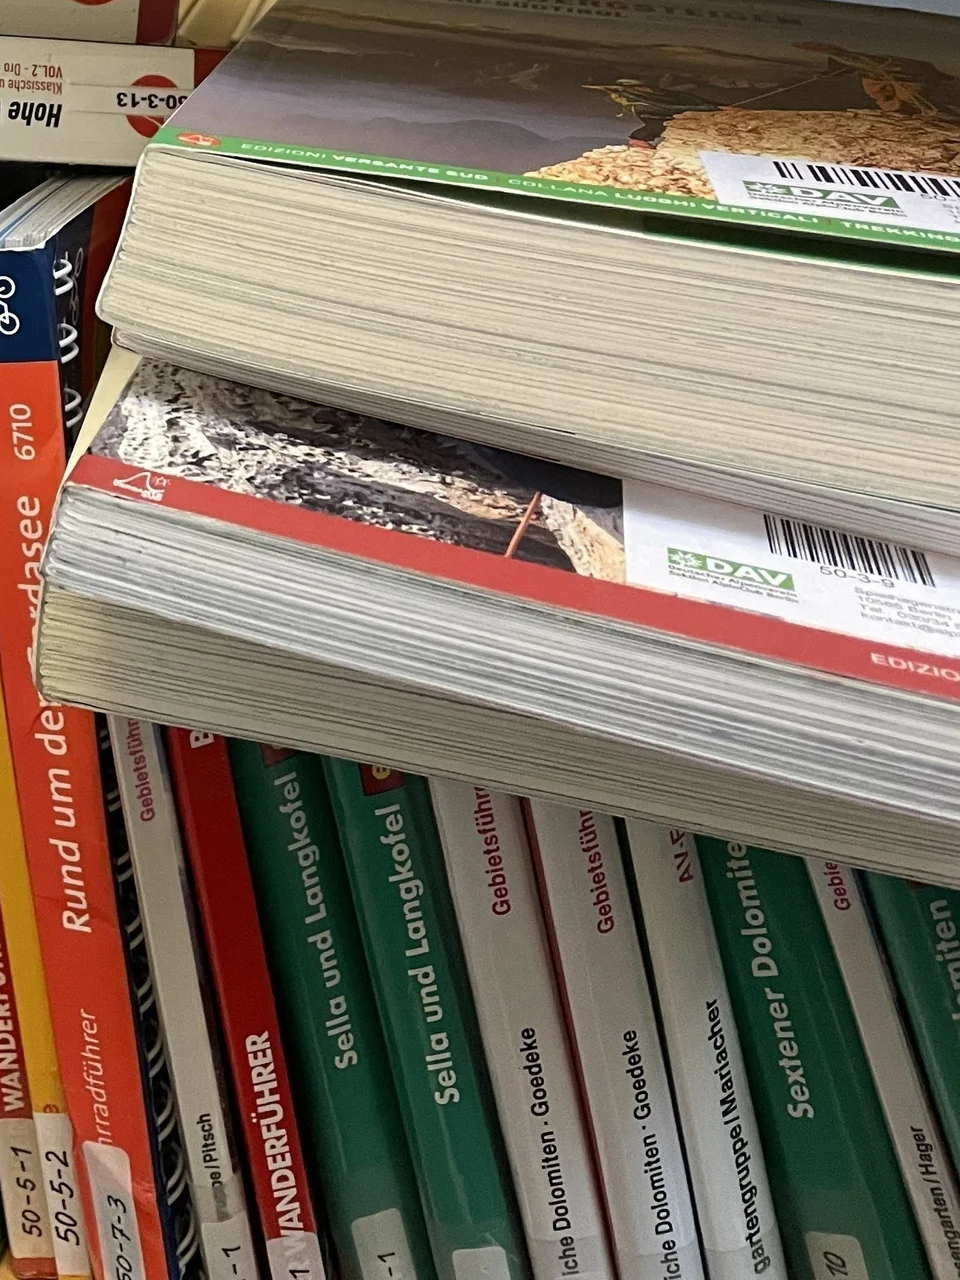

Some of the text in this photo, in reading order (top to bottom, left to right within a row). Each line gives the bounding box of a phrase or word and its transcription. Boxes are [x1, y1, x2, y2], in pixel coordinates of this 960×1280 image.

[8, 100, 62, 128] Hohe
[241, 142, 326, 159] EDIZIONI
[331, 154, 440, 175] VERSANTE
[445, 169, 489, 181] SUD
[508, 178, 608, 198] COLLANA
[700, 202, 819, 224] VERTICALI
[790, 187, 888, 206] DAV
[8, 403, 37, 462] 6710
[705, 552, 789, 588] DAV
[819, 566, 895, 588] 50-3-9
[48, 768, 76, 828] um
[49, 839, 93, 934] Rund
[273, 771, 359, 1070] Sella und Langkofel
[374, 803, 461, 1105] Sella und Langkofel
[760, 988, 816, 1118] Sextener
[516, 1027, 573, 1232] Dolomiten Goedeke
[620, 1029, 674, 1235] Dolomiten Goedeke
[10, 1145, 42, 1238] 50-5-1
[45, 1149, 81, 1246] 50-5-2
